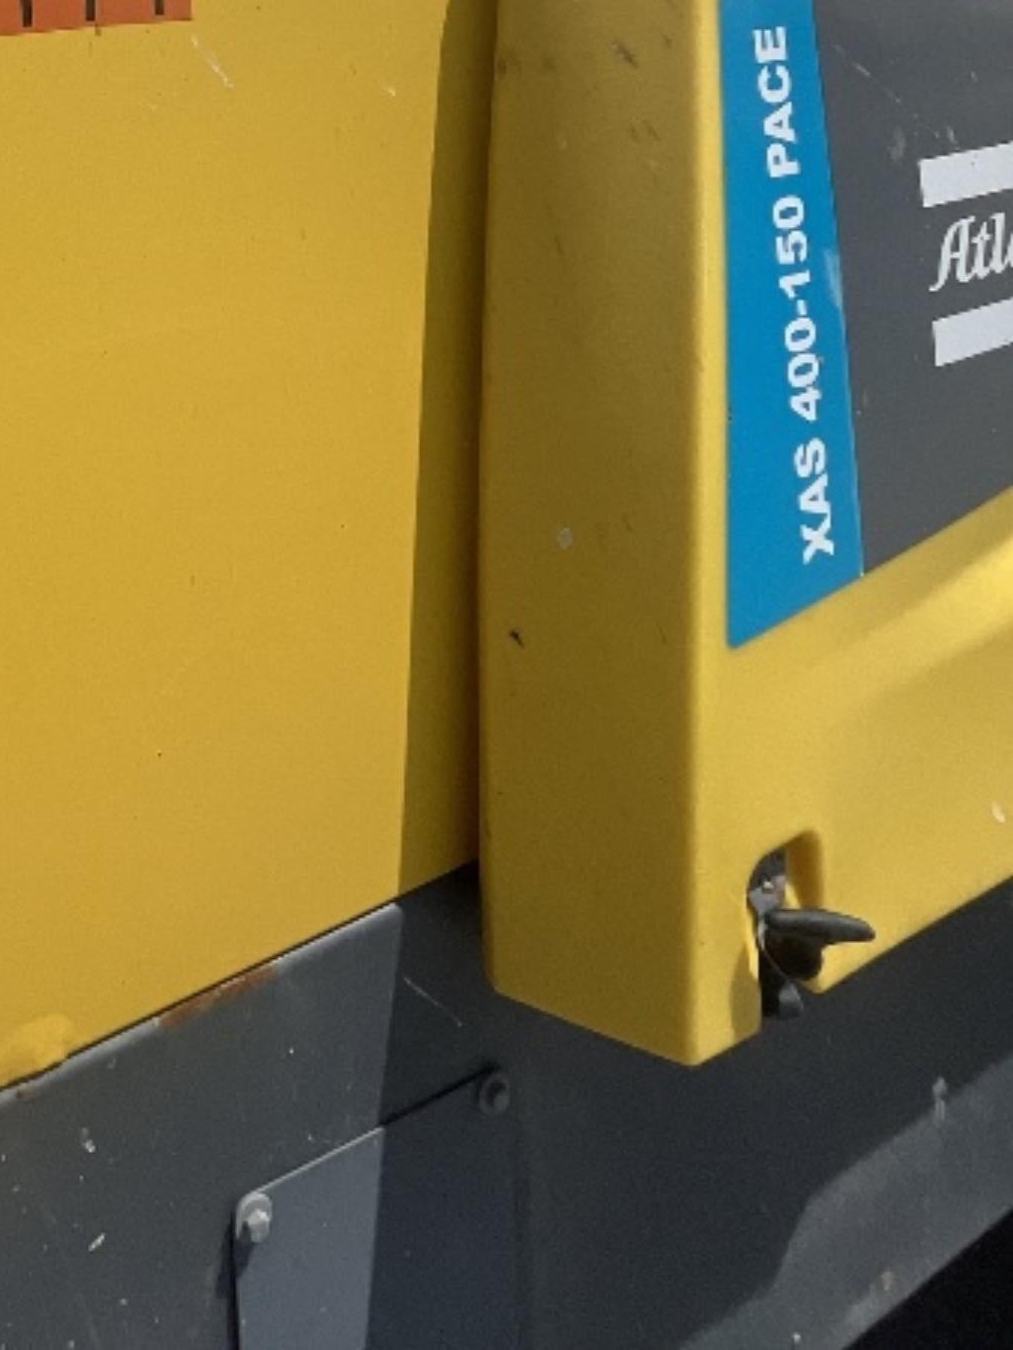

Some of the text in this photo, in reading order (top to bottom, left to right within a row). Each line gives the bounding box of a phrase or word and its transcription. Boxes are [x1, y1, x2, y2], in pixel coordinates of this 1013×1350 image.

[754, 26, 836, 564] XAS 400-150 PACE
